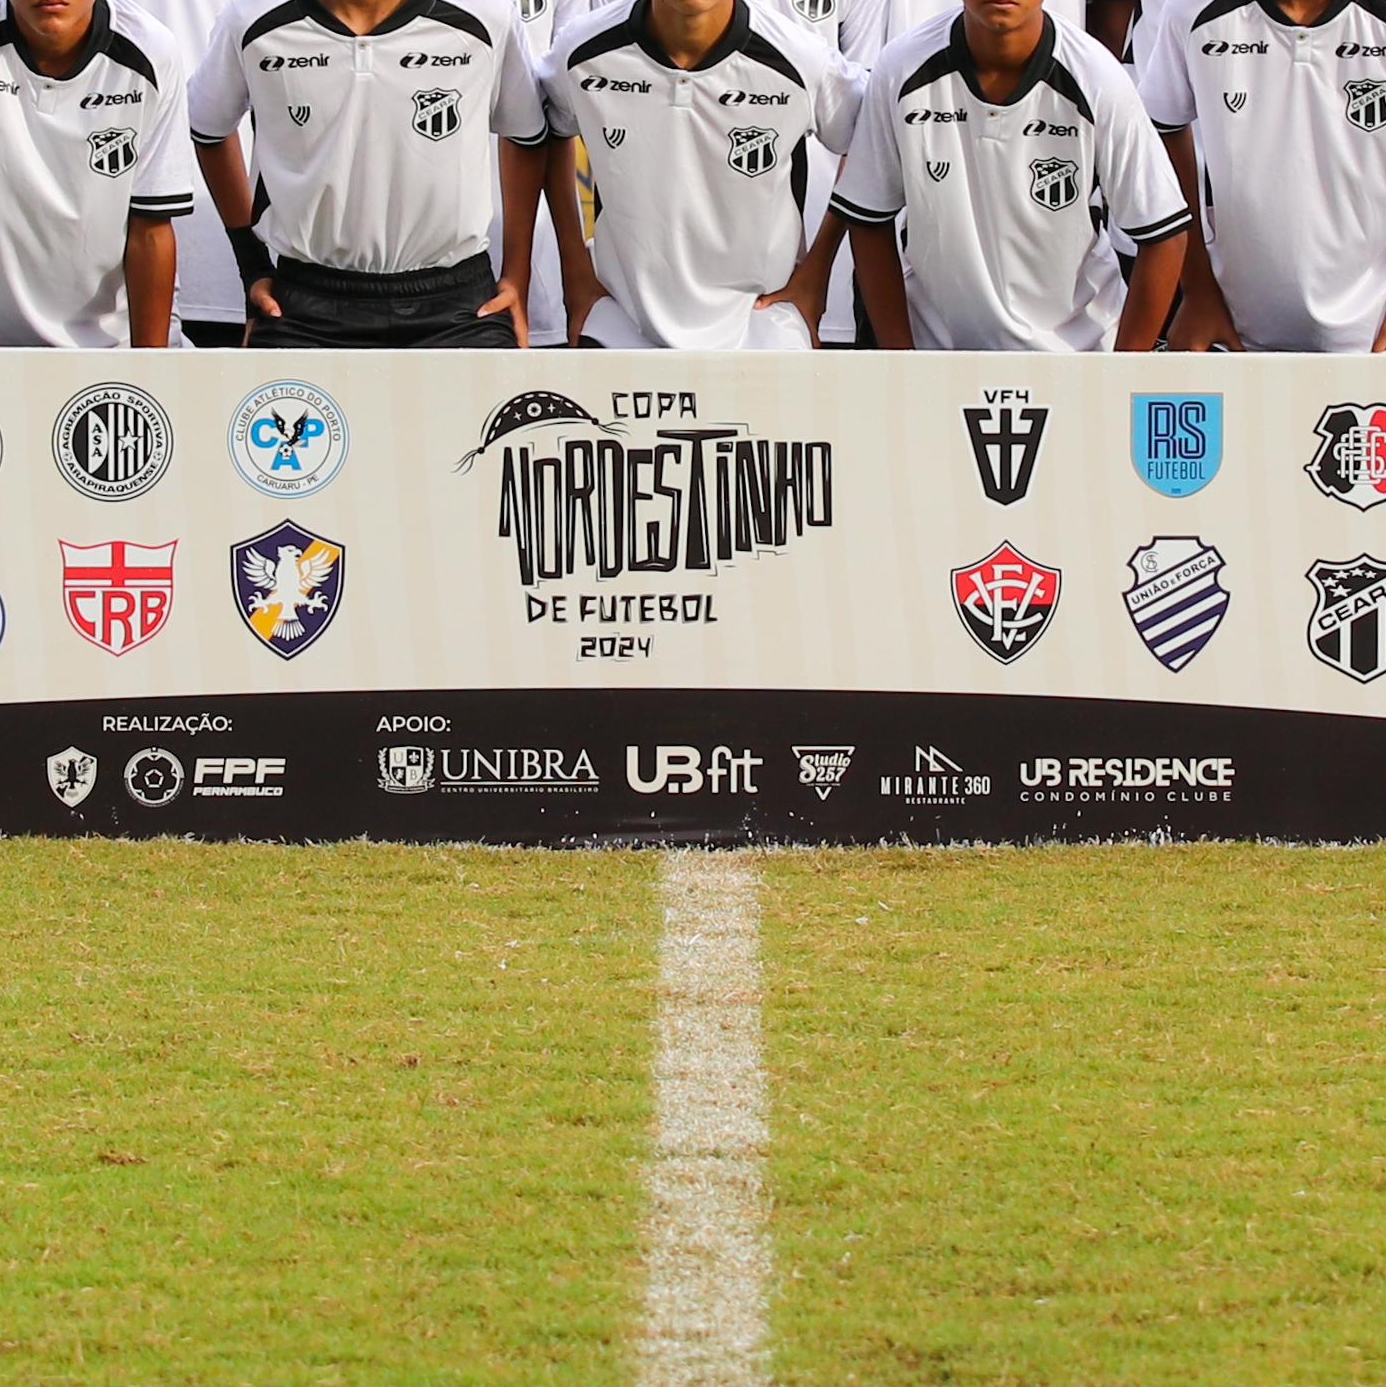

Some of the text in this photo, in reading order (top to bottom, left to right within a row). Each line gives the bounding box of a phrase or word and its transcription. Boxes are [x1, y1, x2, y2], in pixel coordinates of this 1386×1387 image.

[1231, 40, 1270, 54] zenir
[287, 53, 472, 69] zenir zenir
[103, 89, 144, 106] zenir
[609, 80, 791, 105] zenir zenir
[933, 108, 968, 123] zenir
[611, 391, 697, 419] COPA
[984, 390, 1028, 404] VF4
[127, 395, 163, 449] SPORTIVA
[235, 405, 255, 442] CLUBE
[307, 391, 322, 406] DO
[321, 404, 342, 442] PORTO
[1148, 401, 1206, 459] RS
[67, 460, 158, 493] ARAPIRAQUENSE
[256, 474, 301, 490] CARUARU
[1148, 461, 1205, 480] FUTEBOL
[499, 429, 832, 586] NORDESTINHO
[1176, 555, 1216, 582] FORÇA
[525, 591, 718, 624] DE FUTEBOL
[69, 591, 167, 649] CRB
[579, 635, 653, 659] 2024
[103, 713, 233, 735] REALIZAÇÃO:
[376, 716, 452, 732] APOIO:
[193, 758, 286, 784] FPF
[440, 748, 600, 780] UNIBRA
[815, 766, 846, 783] 257
[1020, 758, 1236, 787] UB RESIDENCE
[193, 786, 284, 797] PERNAMBUCO
[880, 775, 991, 795] MIRANTE 360
[1167, 791, 1232, 802] CLUBE
[905, 797, 966, 805] RESTAURANTE
